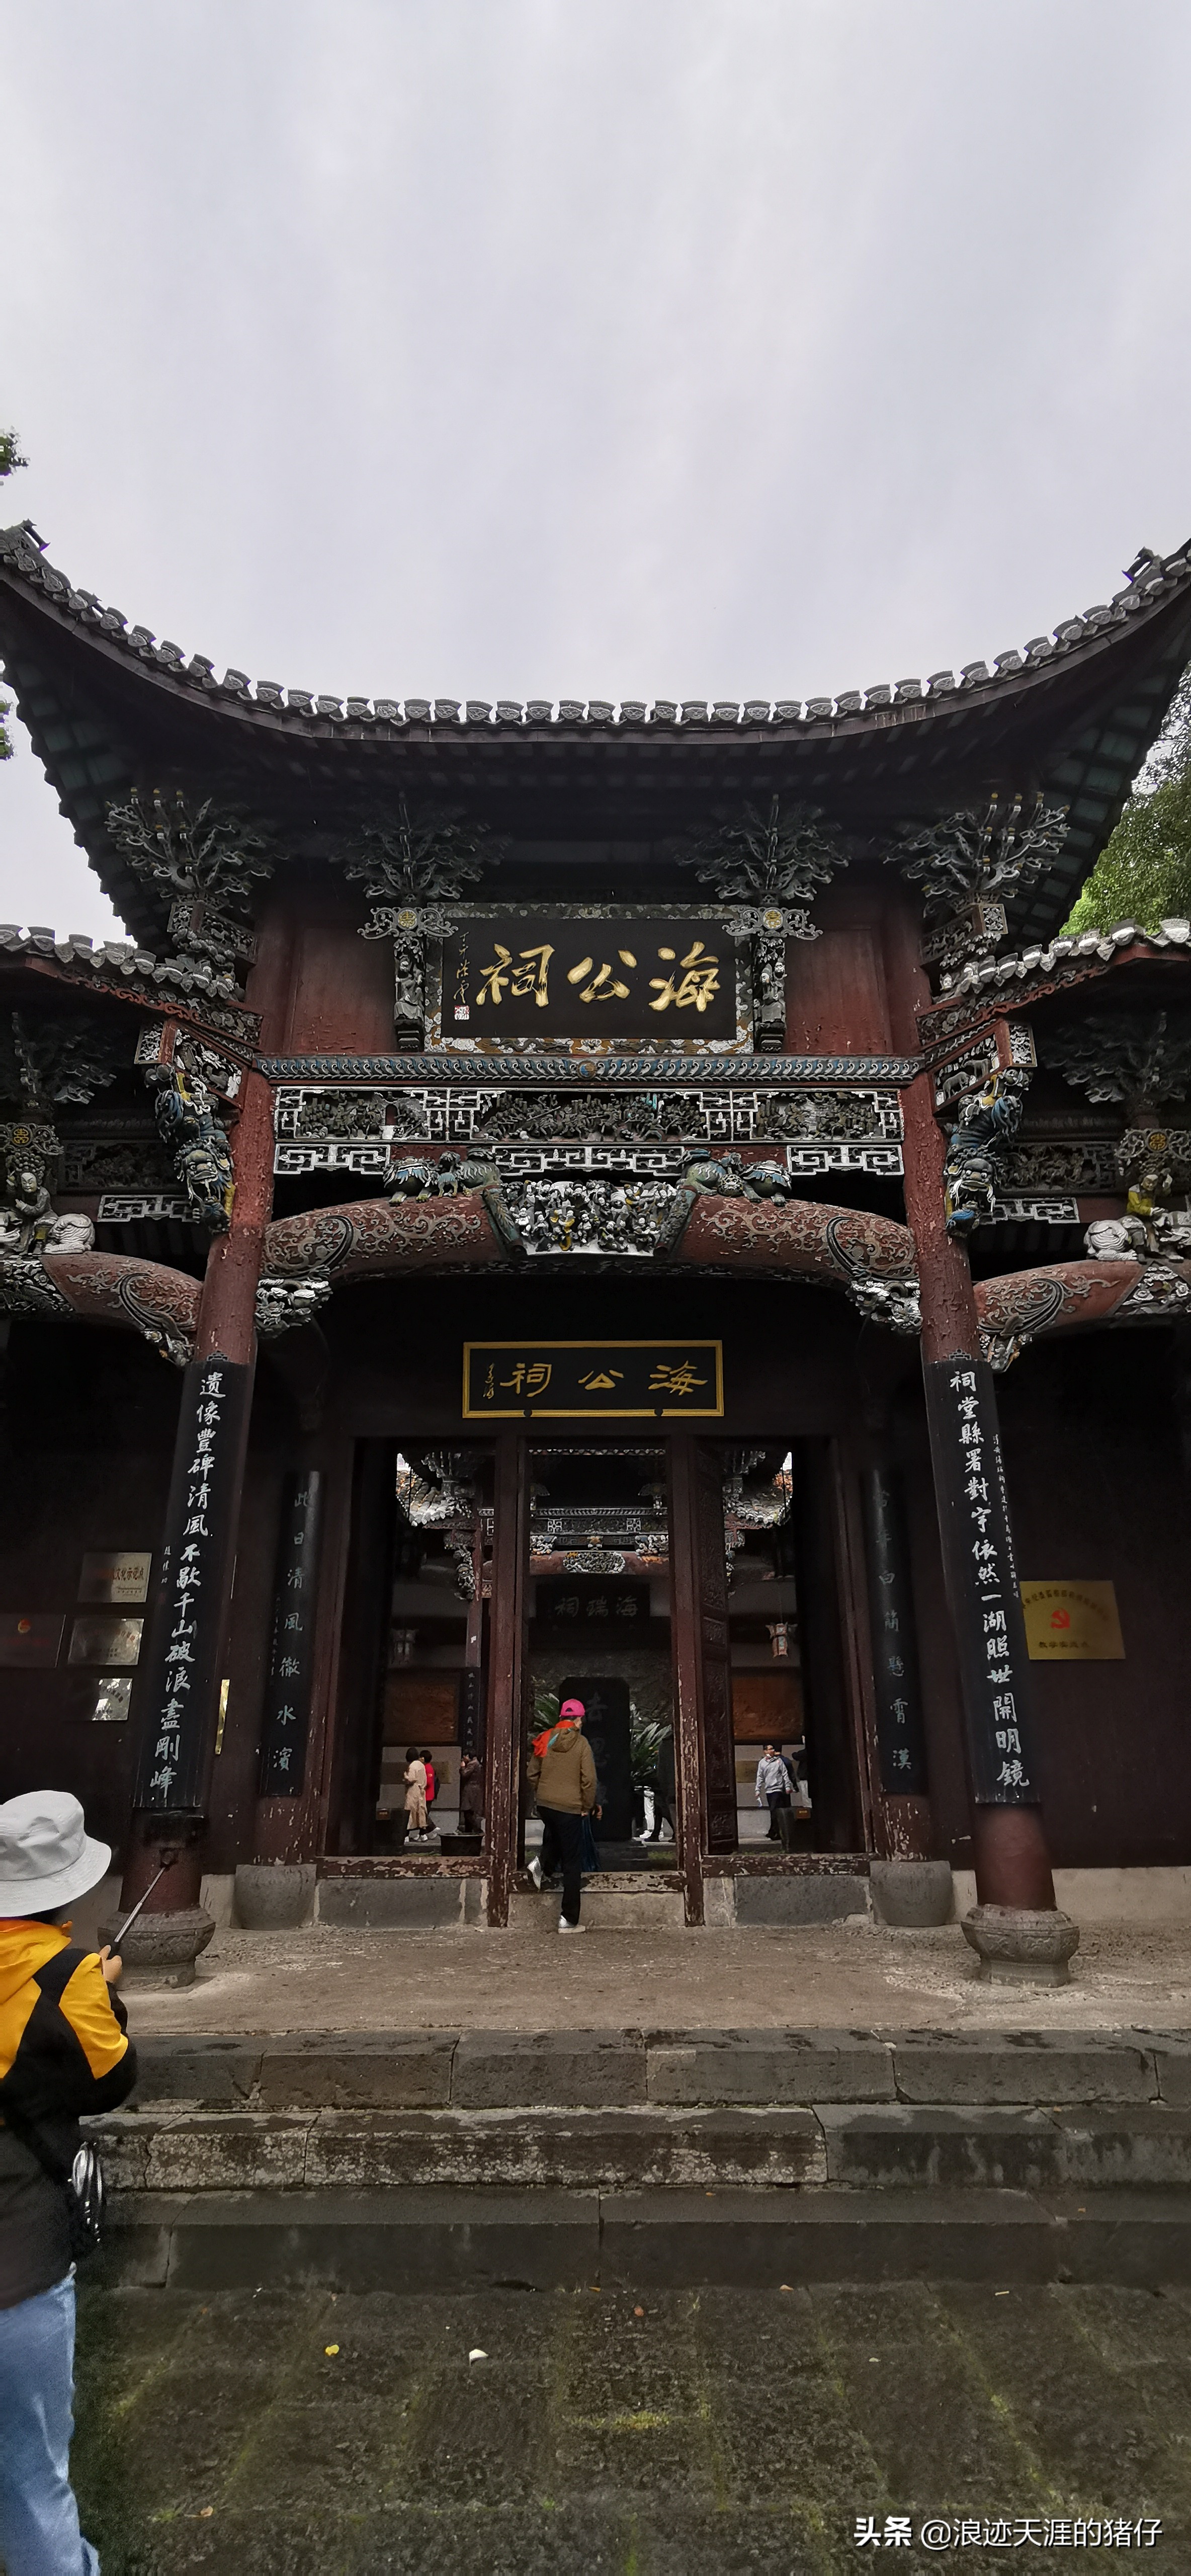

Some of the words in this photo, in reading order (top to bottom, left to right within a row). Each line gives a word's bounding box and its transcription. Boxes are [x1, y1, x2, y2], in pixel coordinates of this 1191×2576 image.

[475, 941, 719, 1013] 海公祠
[499, 1360, 708, 1397] 海公祠
